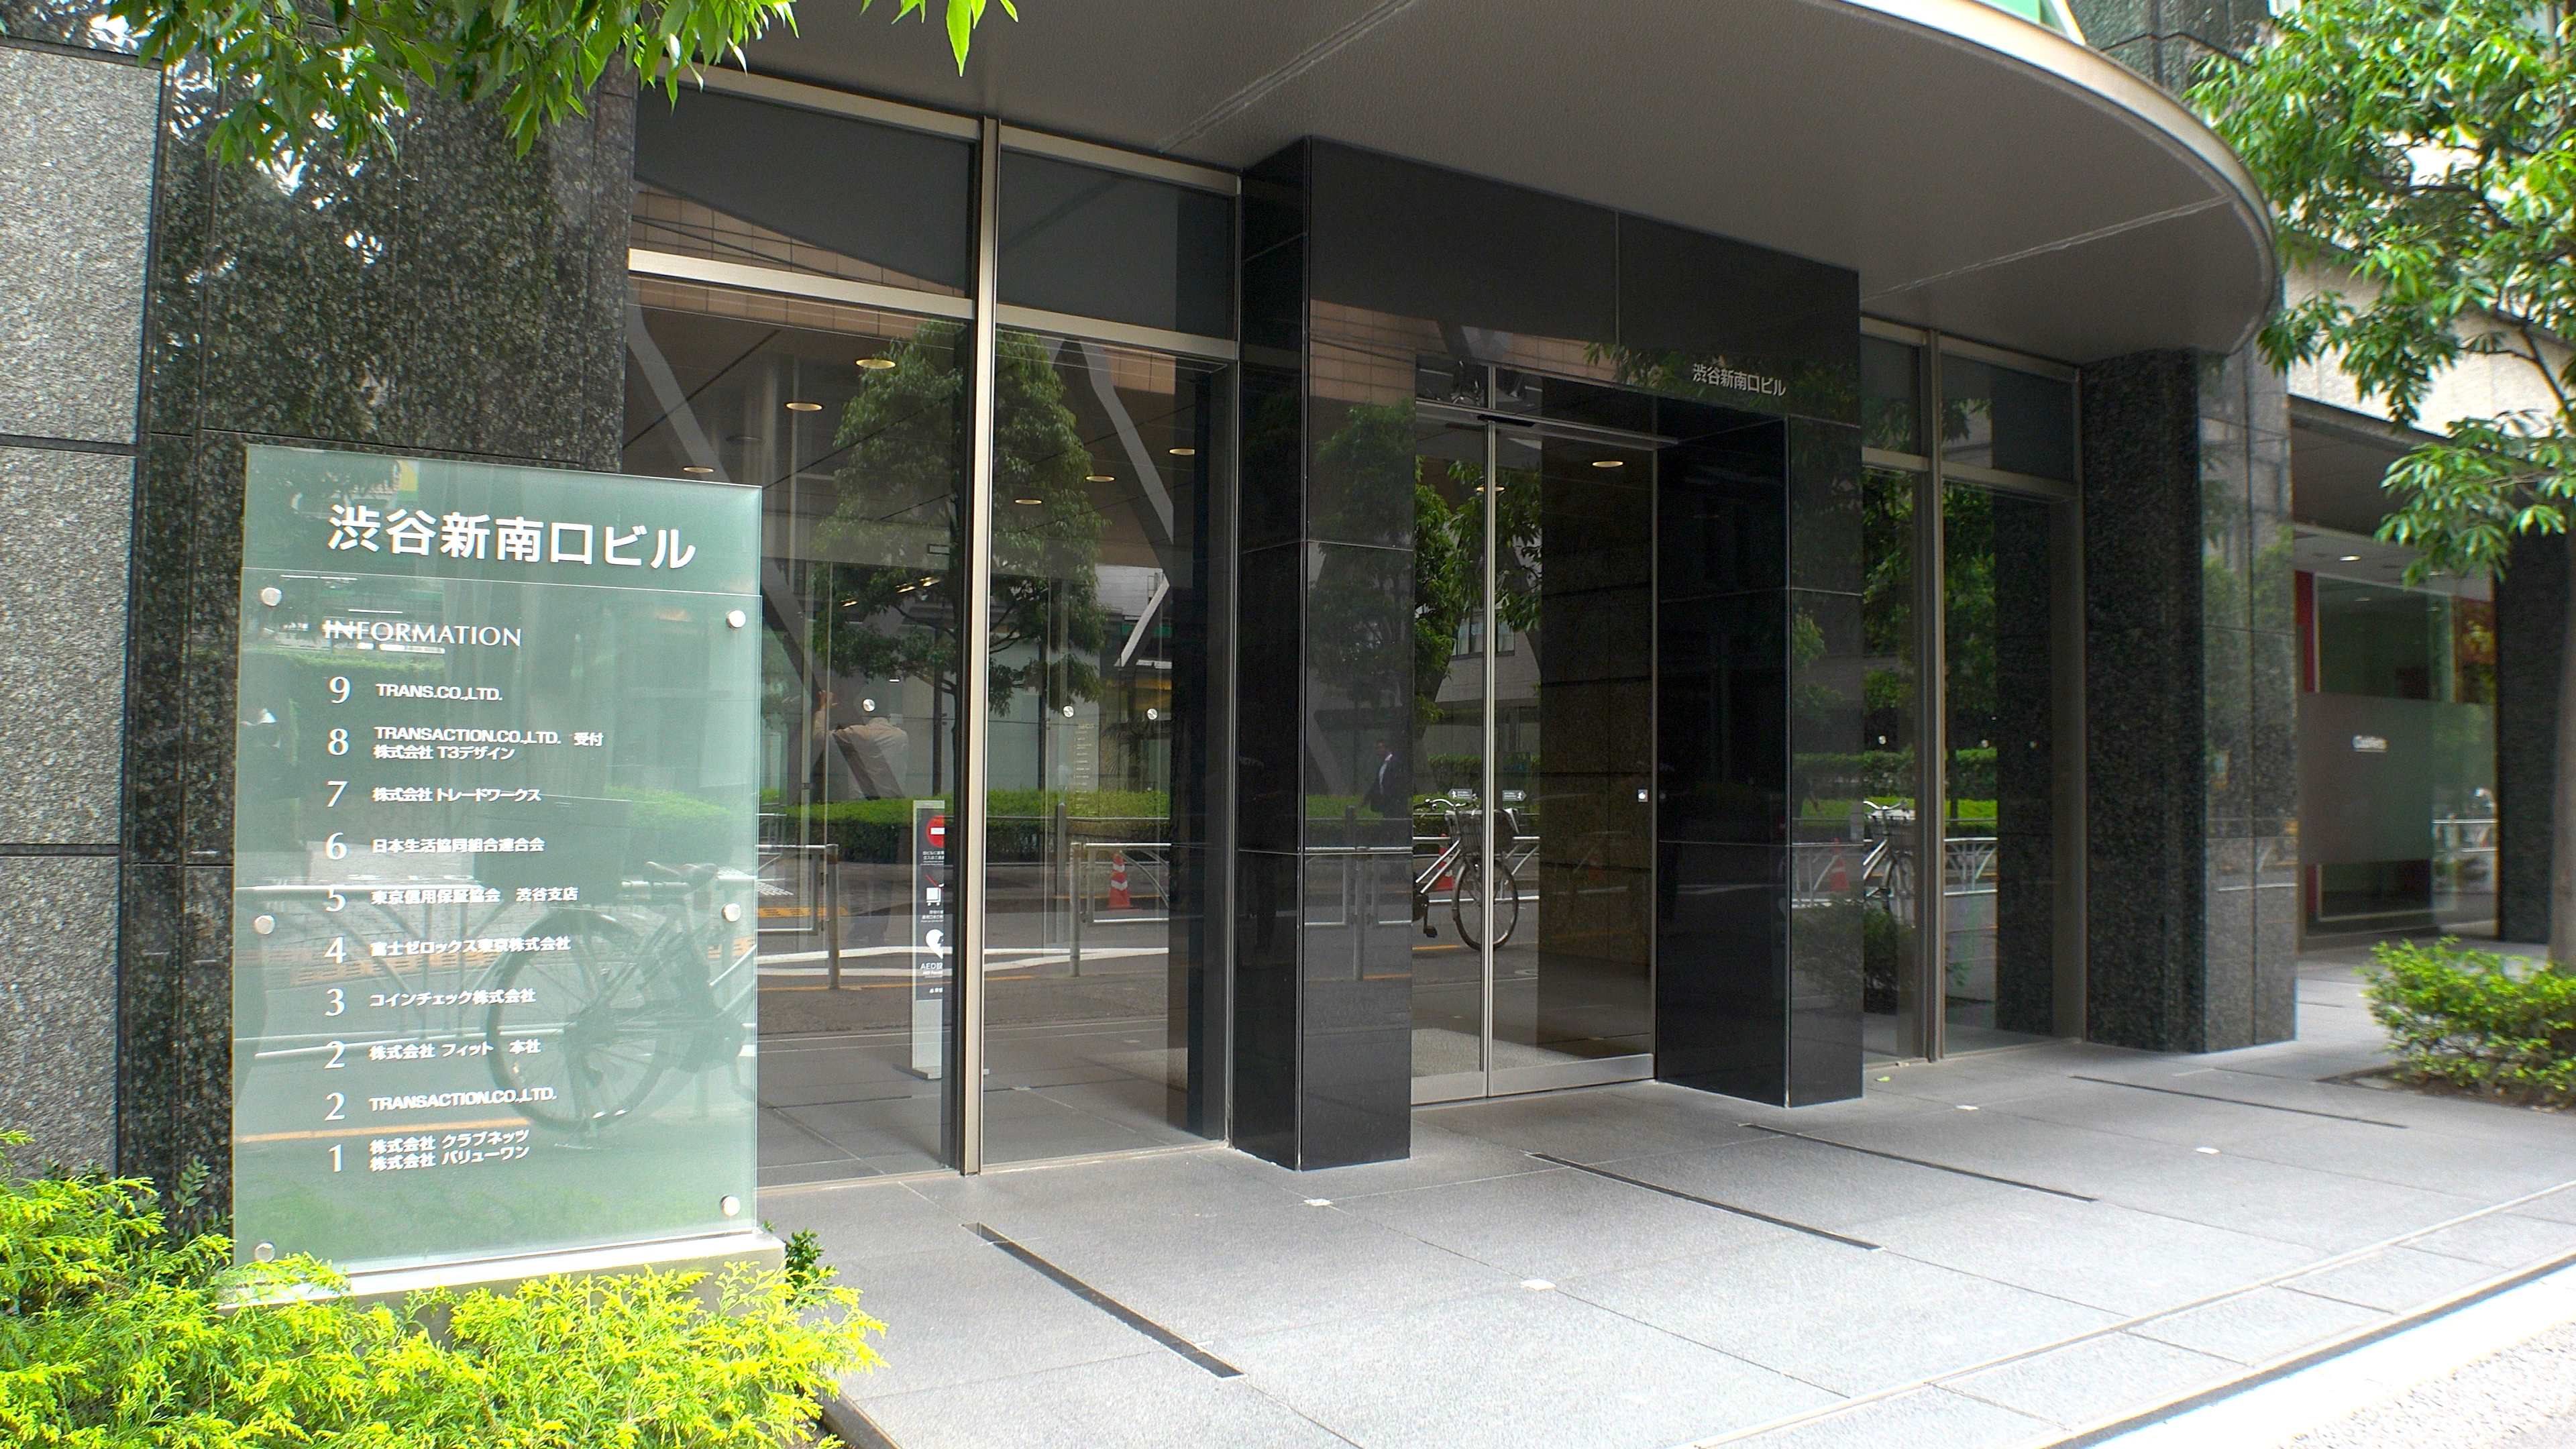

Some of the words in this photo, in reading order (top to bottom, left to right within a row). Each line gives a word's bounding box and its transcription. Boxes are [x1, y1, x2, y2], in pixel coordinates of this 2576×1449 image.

[1693, 363, 1786, 396] 渋谷新南口ビル
[327, 504, 696, 570] 渋谷新南口ビル
[323, 619, 522, 647] INFORMATION
[329, 676, 351, 704] 9
[327, 729, 349, 756] 8
[574, 732, 603, 746] 受付
[373, 745, 433, 759] 株式会社
[437, 746, 515, 760] T3デザイン
[326, 780, 348, 808] 7
[372, 787, 433, 802] 株式会社
[437, 788, 542, 802] トレードワークス
[325, 832, 347, 860] 6
[372, 837, 545, 853] 日本生活協同組合連合会
[325, 883, 346, 912] 5
[371, 888, 501, 905] 東京信用保証協会
[516, 886, 578, 902] 渋谷支店
[324, 936, 346, 964] 4
[370, 936, 571, 957] 富士ゼロックス東京株式会社
[325, 987, 345, 1016] 3
[370, 988, 536, 1007] コインチェック株式会社
[324, 1040, 345, 1069] 2
[369, 1043, 435, 1061] 株式会社
[441, 1041, 494, 1057] フィット
[509, 1038, 541, 1054] 本社
[324, 1092, 345, 1121] 2
[327, 1144, 344, 1172] 1
[370, 1135, 436, 1155] 株式会社
[370, 1151, 436, 1172] 株式会社
